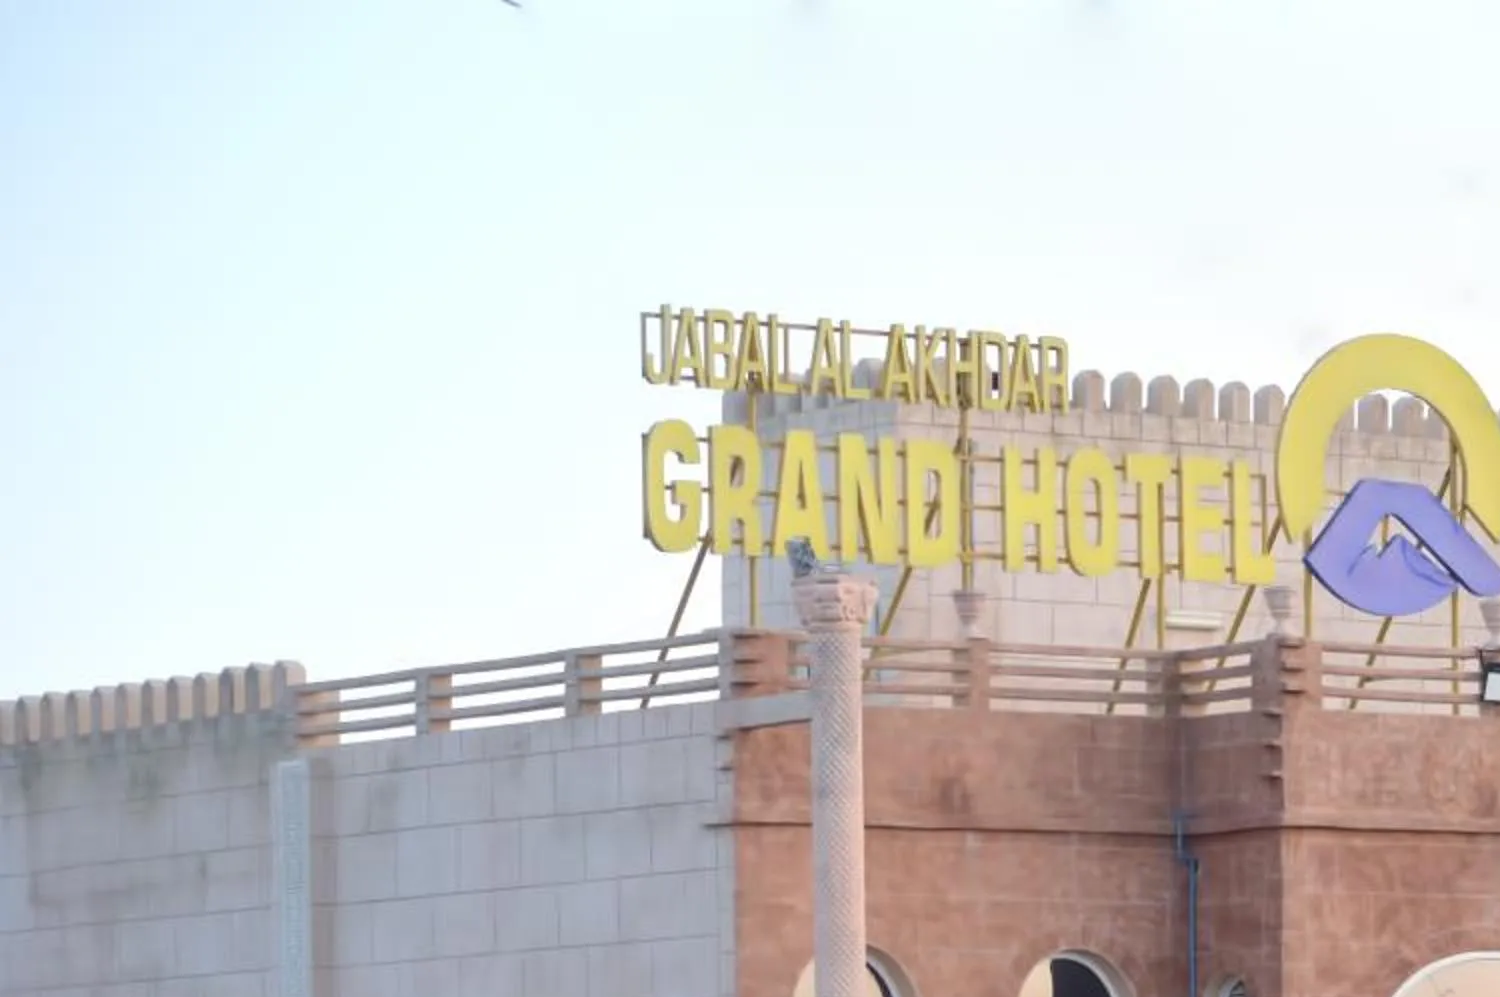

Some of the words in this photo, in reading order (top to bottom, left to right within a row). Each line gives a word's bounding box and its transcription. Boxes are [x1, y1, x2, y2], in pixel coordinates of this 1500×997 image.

[642, 303, 798, 391] JABAL
[808, 317, 871, 399] AL
[881, 323, 1069, 413] AKHDAR
[643, 419, 959, 567] GRAND
[1000, 445, 1277, 586] HOTEL
